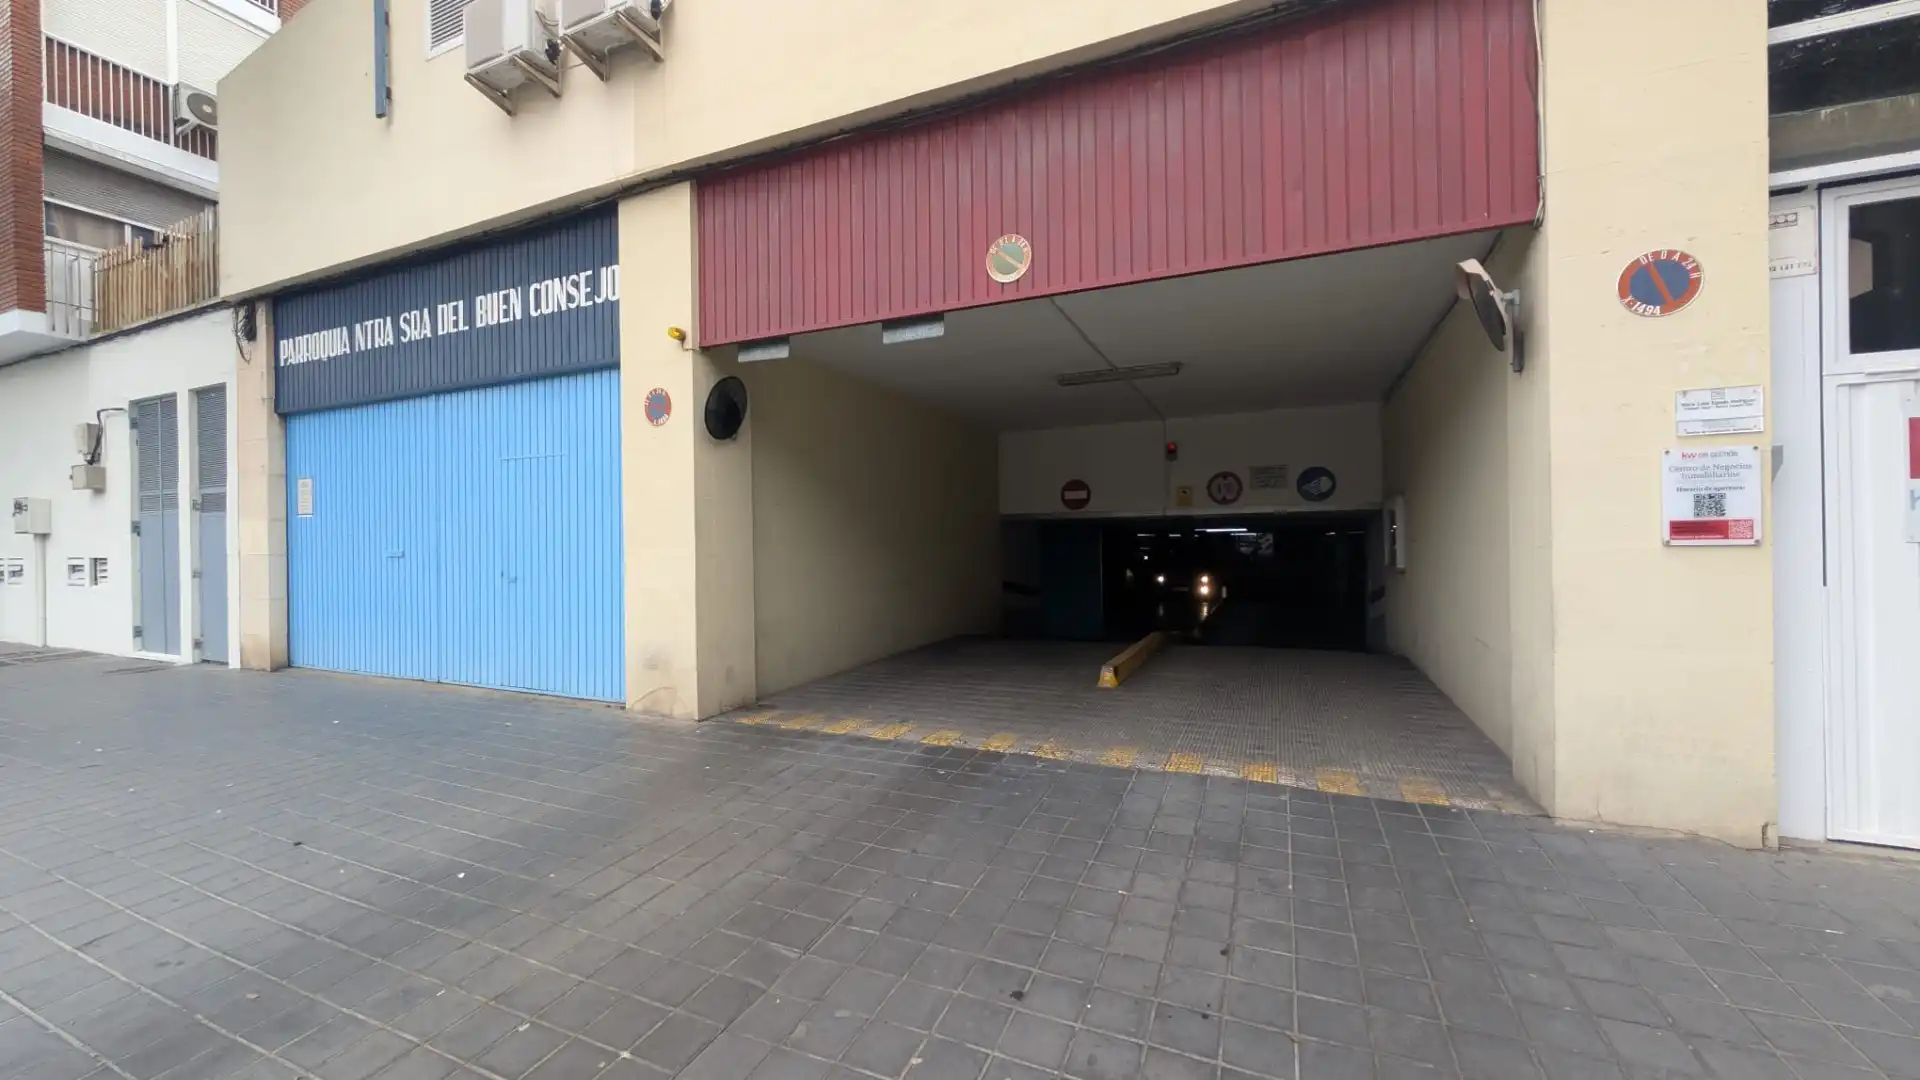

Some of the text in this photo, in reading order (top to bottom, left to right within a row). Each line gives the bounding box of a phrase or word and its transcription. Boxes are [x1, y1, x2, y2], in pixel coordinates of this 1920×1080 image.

[279, 264, 621, 367] PARROQUIA NTRA SRA DEL BUEN CONSEJO
